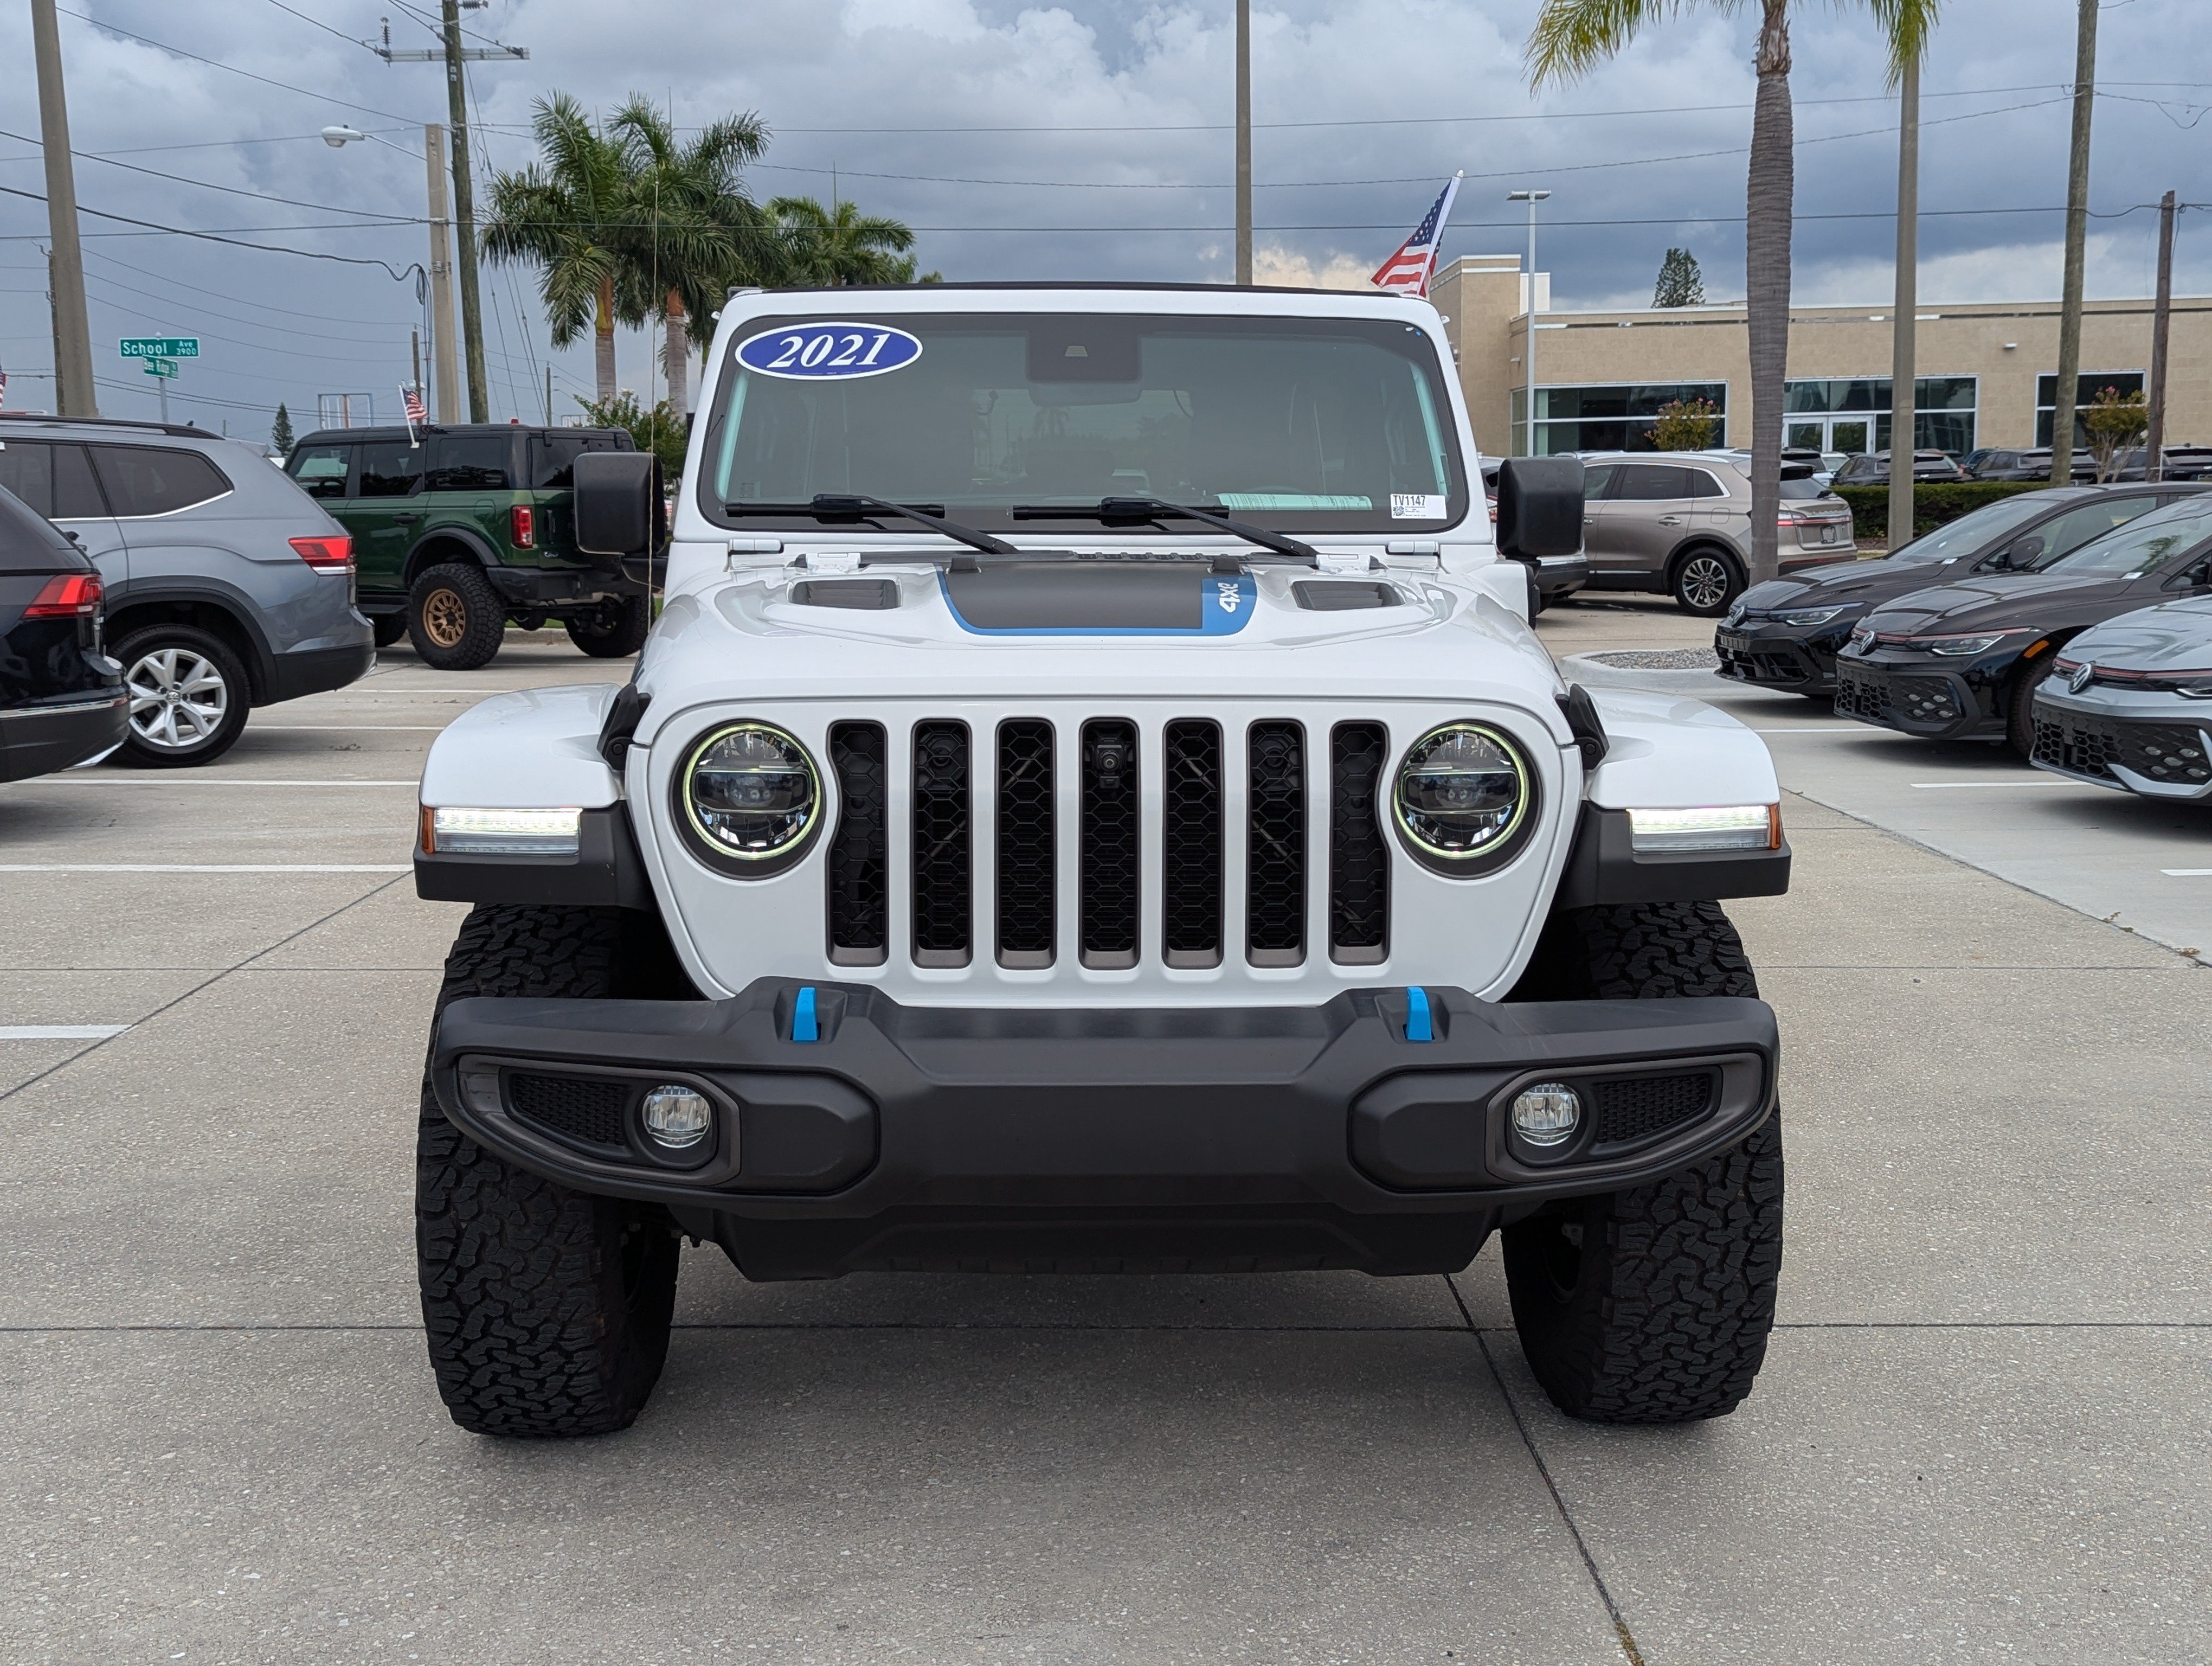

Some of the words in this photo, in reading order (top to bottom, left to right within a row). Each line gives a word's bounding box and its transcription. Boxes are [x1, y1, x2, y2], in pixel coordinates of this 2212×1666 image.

[123, 342, 168, 355] School
[766, 334, 891, 368] 2021
[1393, 495, 1426, 506] TV1147
